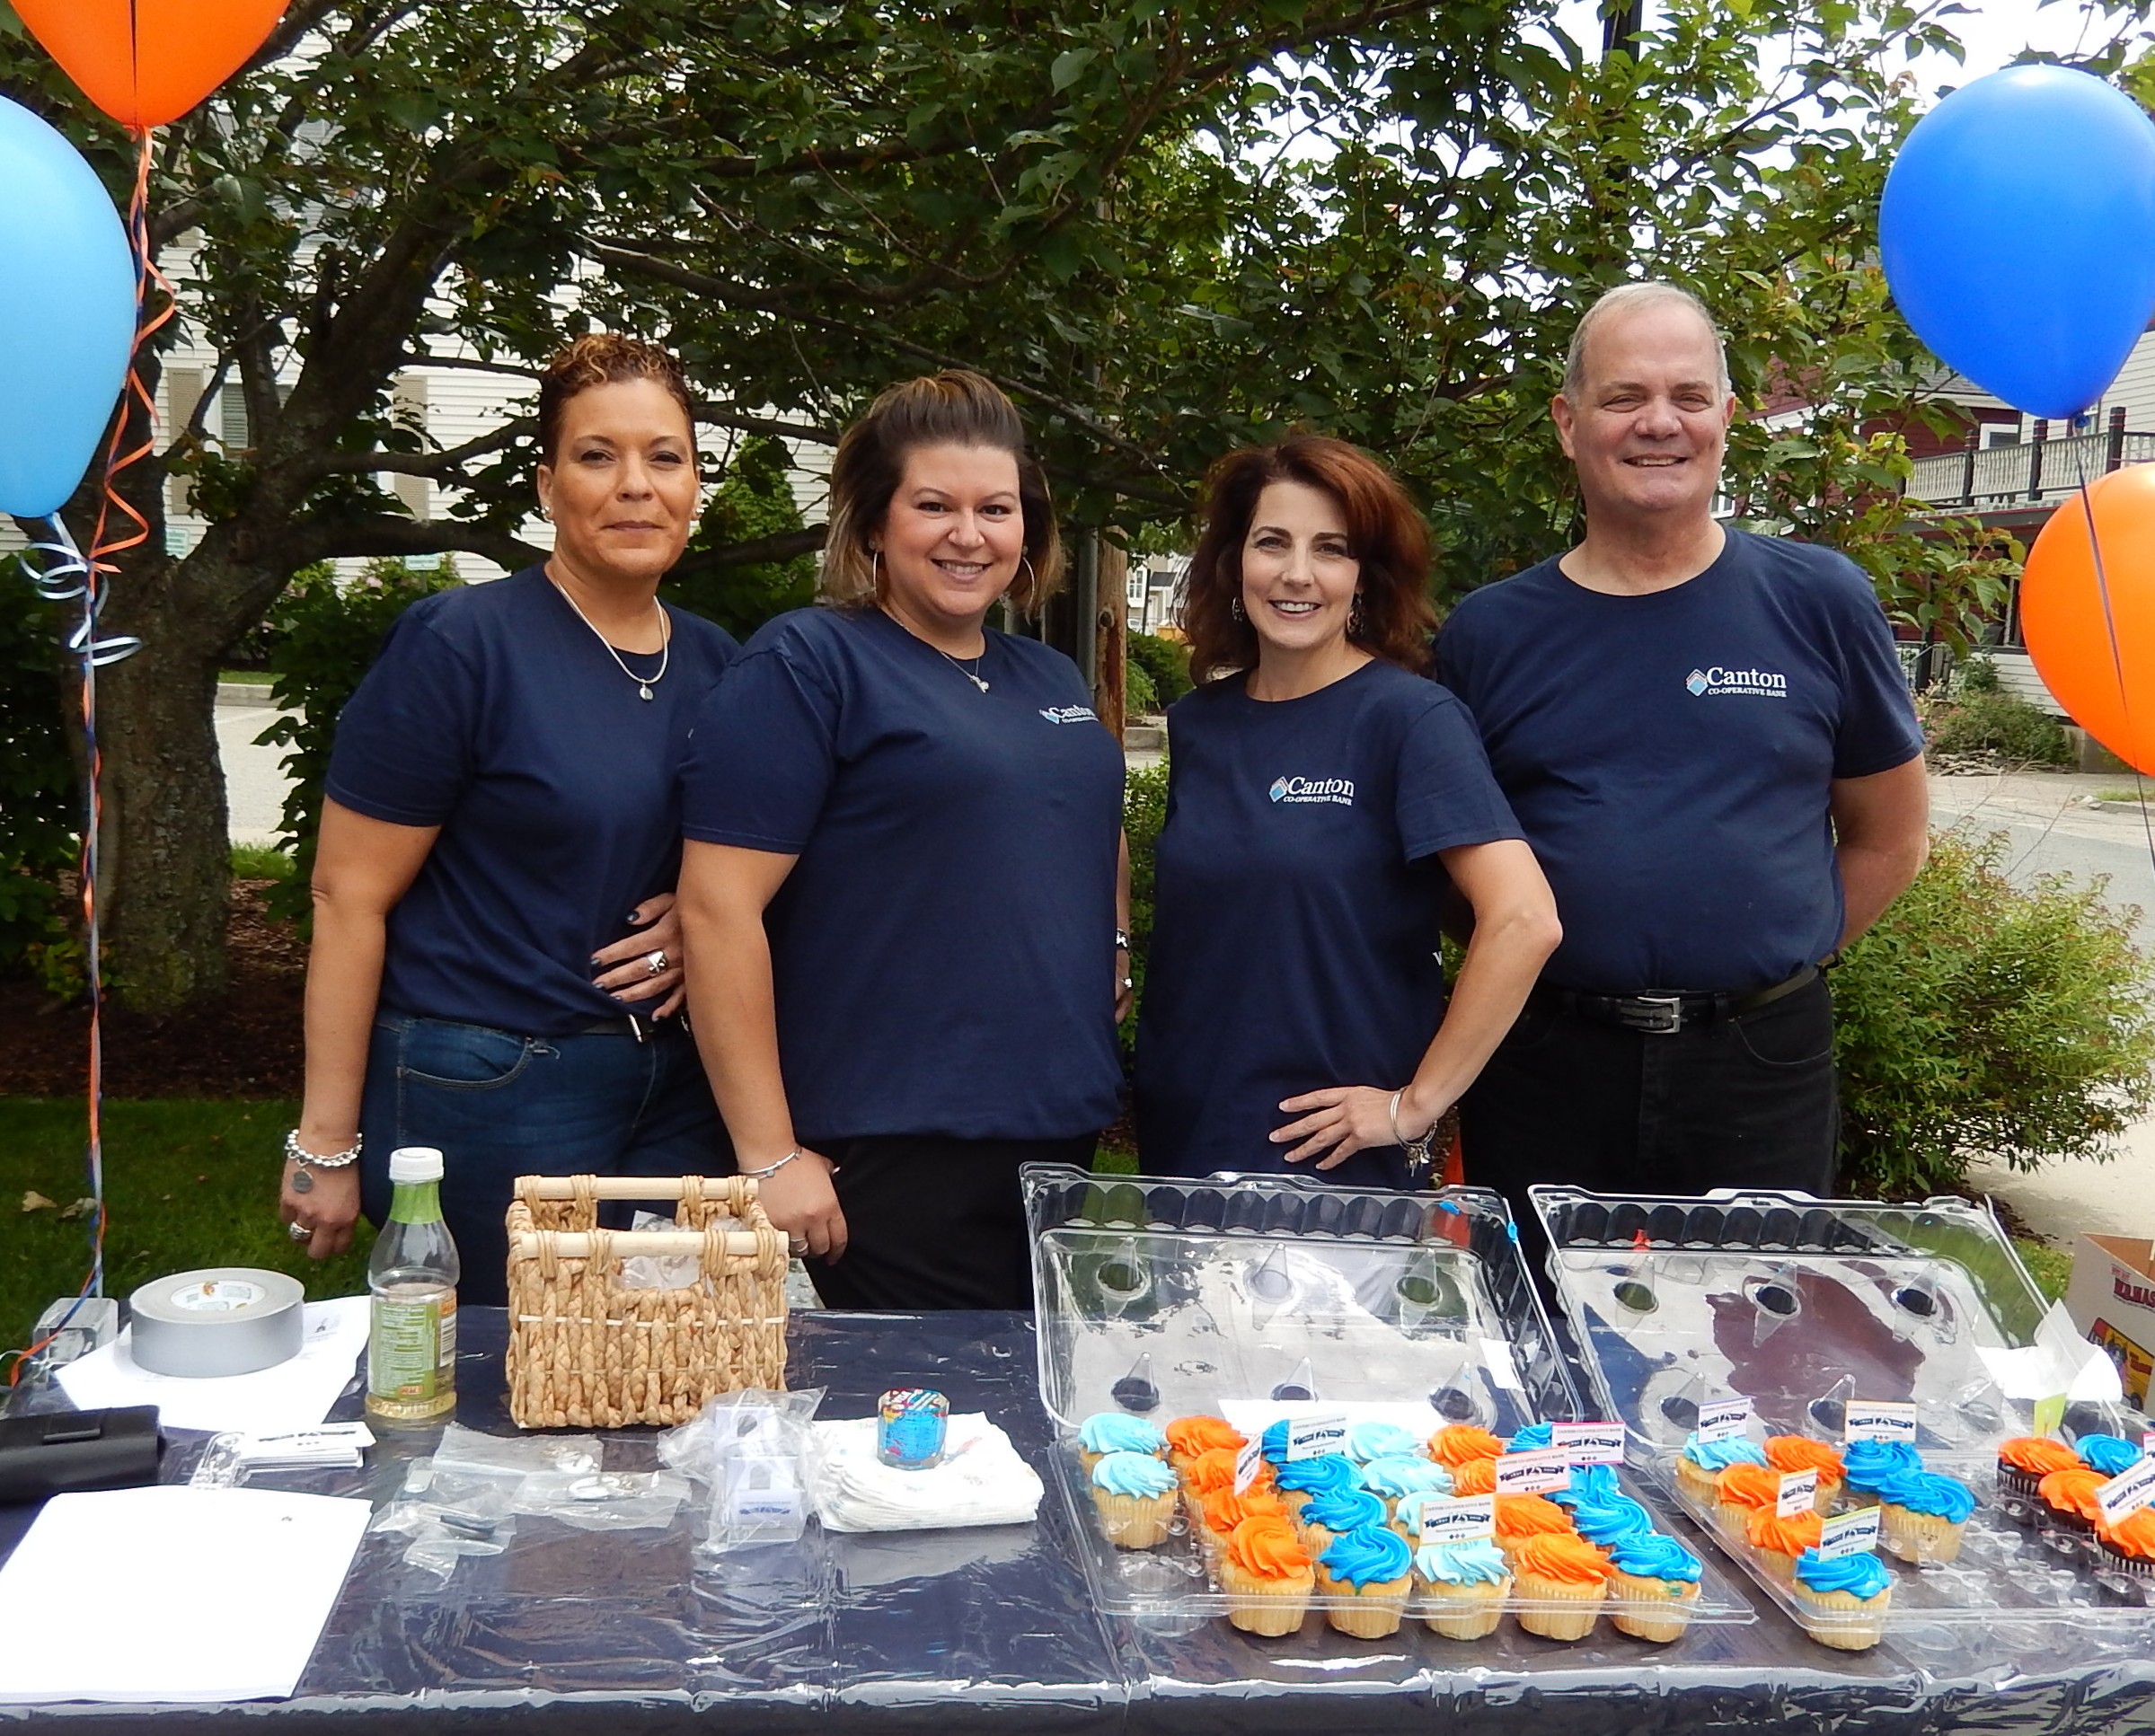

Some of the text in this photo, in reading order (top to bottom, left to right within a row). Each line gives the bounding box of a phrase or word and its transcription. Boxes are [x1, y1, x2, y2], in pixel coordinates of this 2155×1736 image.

[1707, 666, 1787, 689] Canton
[1708, 687, 1765, 696] CO-OPERATIVE
[1287, 776, 1355, 798] Canton
